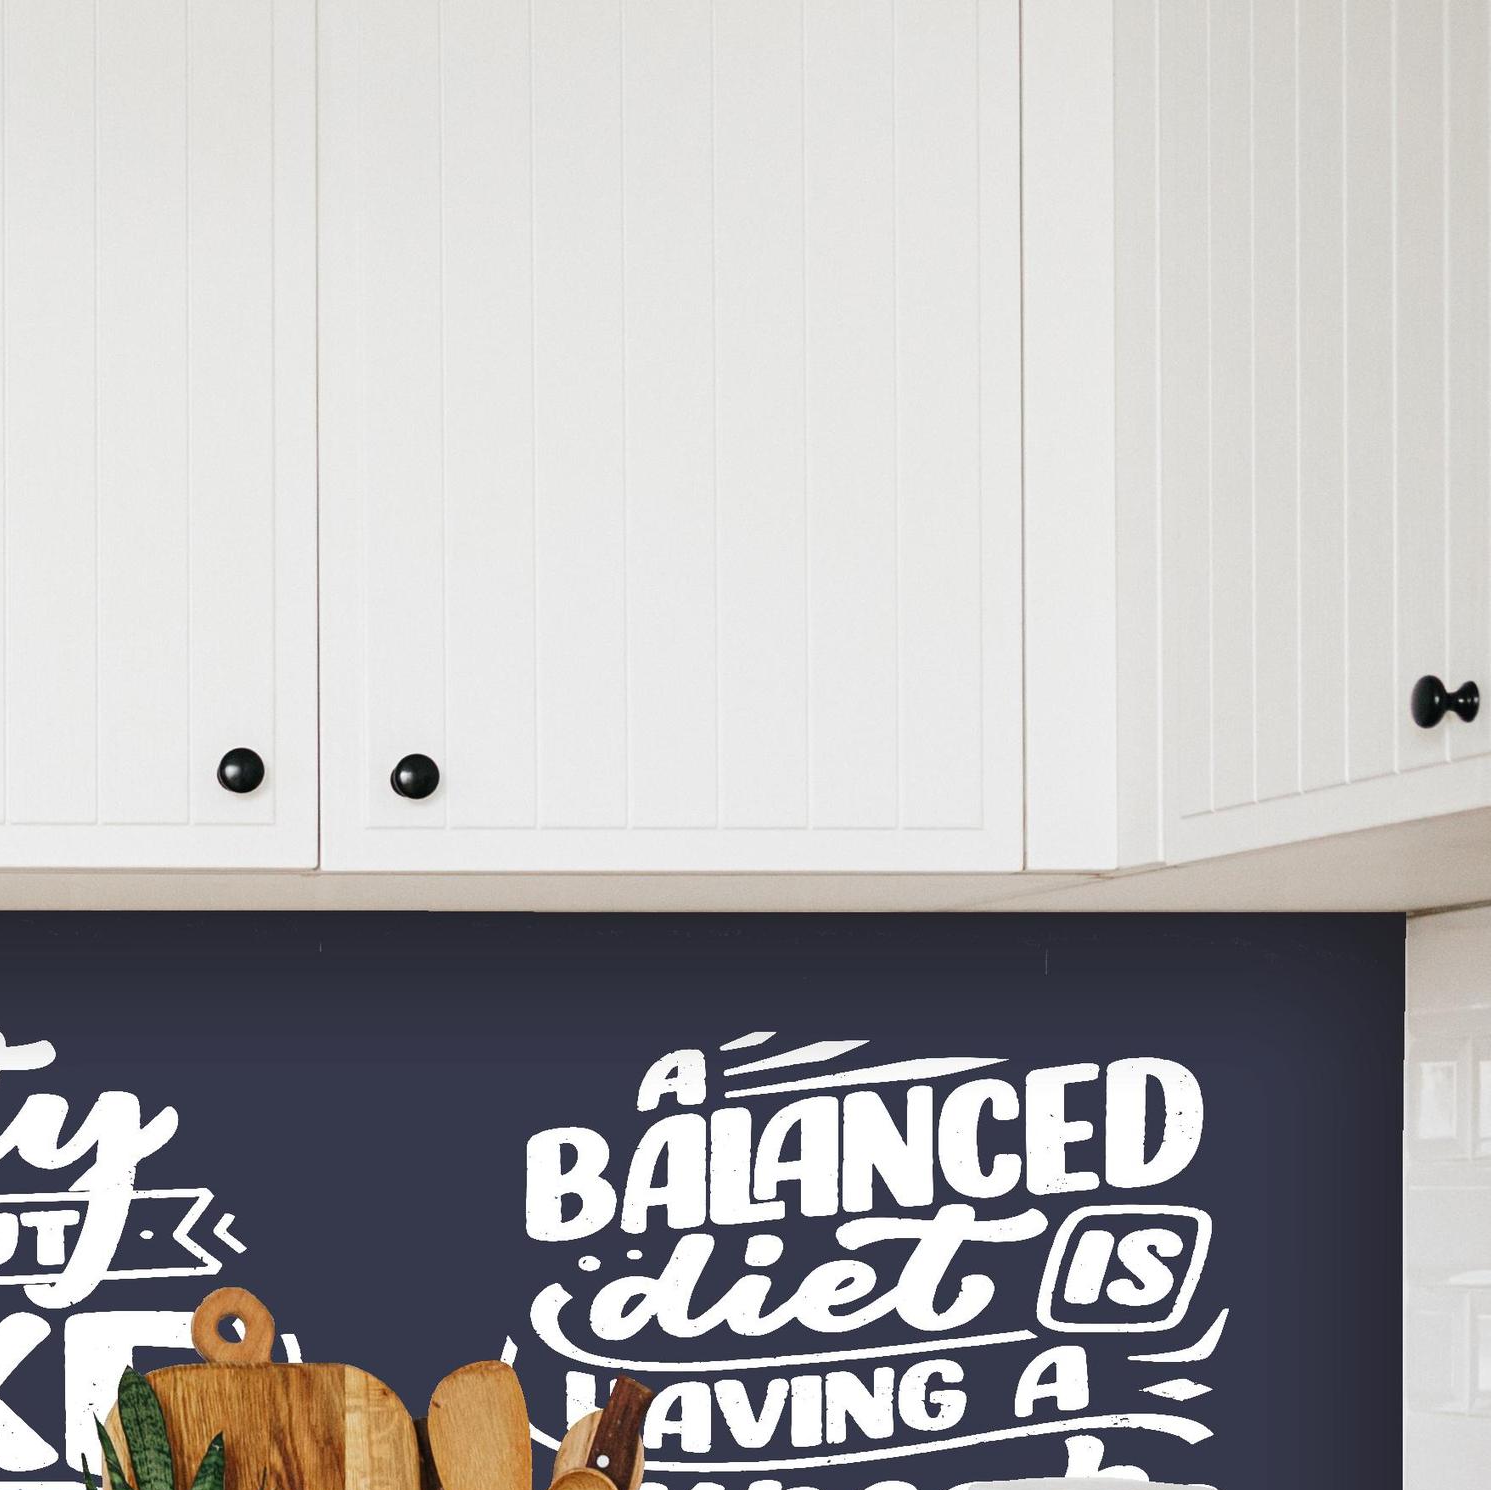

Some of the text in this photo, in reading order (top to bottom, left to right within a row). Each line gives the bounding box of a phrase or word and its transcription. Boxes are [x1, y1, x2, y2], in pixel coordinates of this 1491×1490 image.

[637, 1050, 707, 1112] A
[526, 1058, 1204, 1242] BALANCED
[590, 1204, 1184, 1341] diet IS
[1015, 1345, 1090, 1418] A
